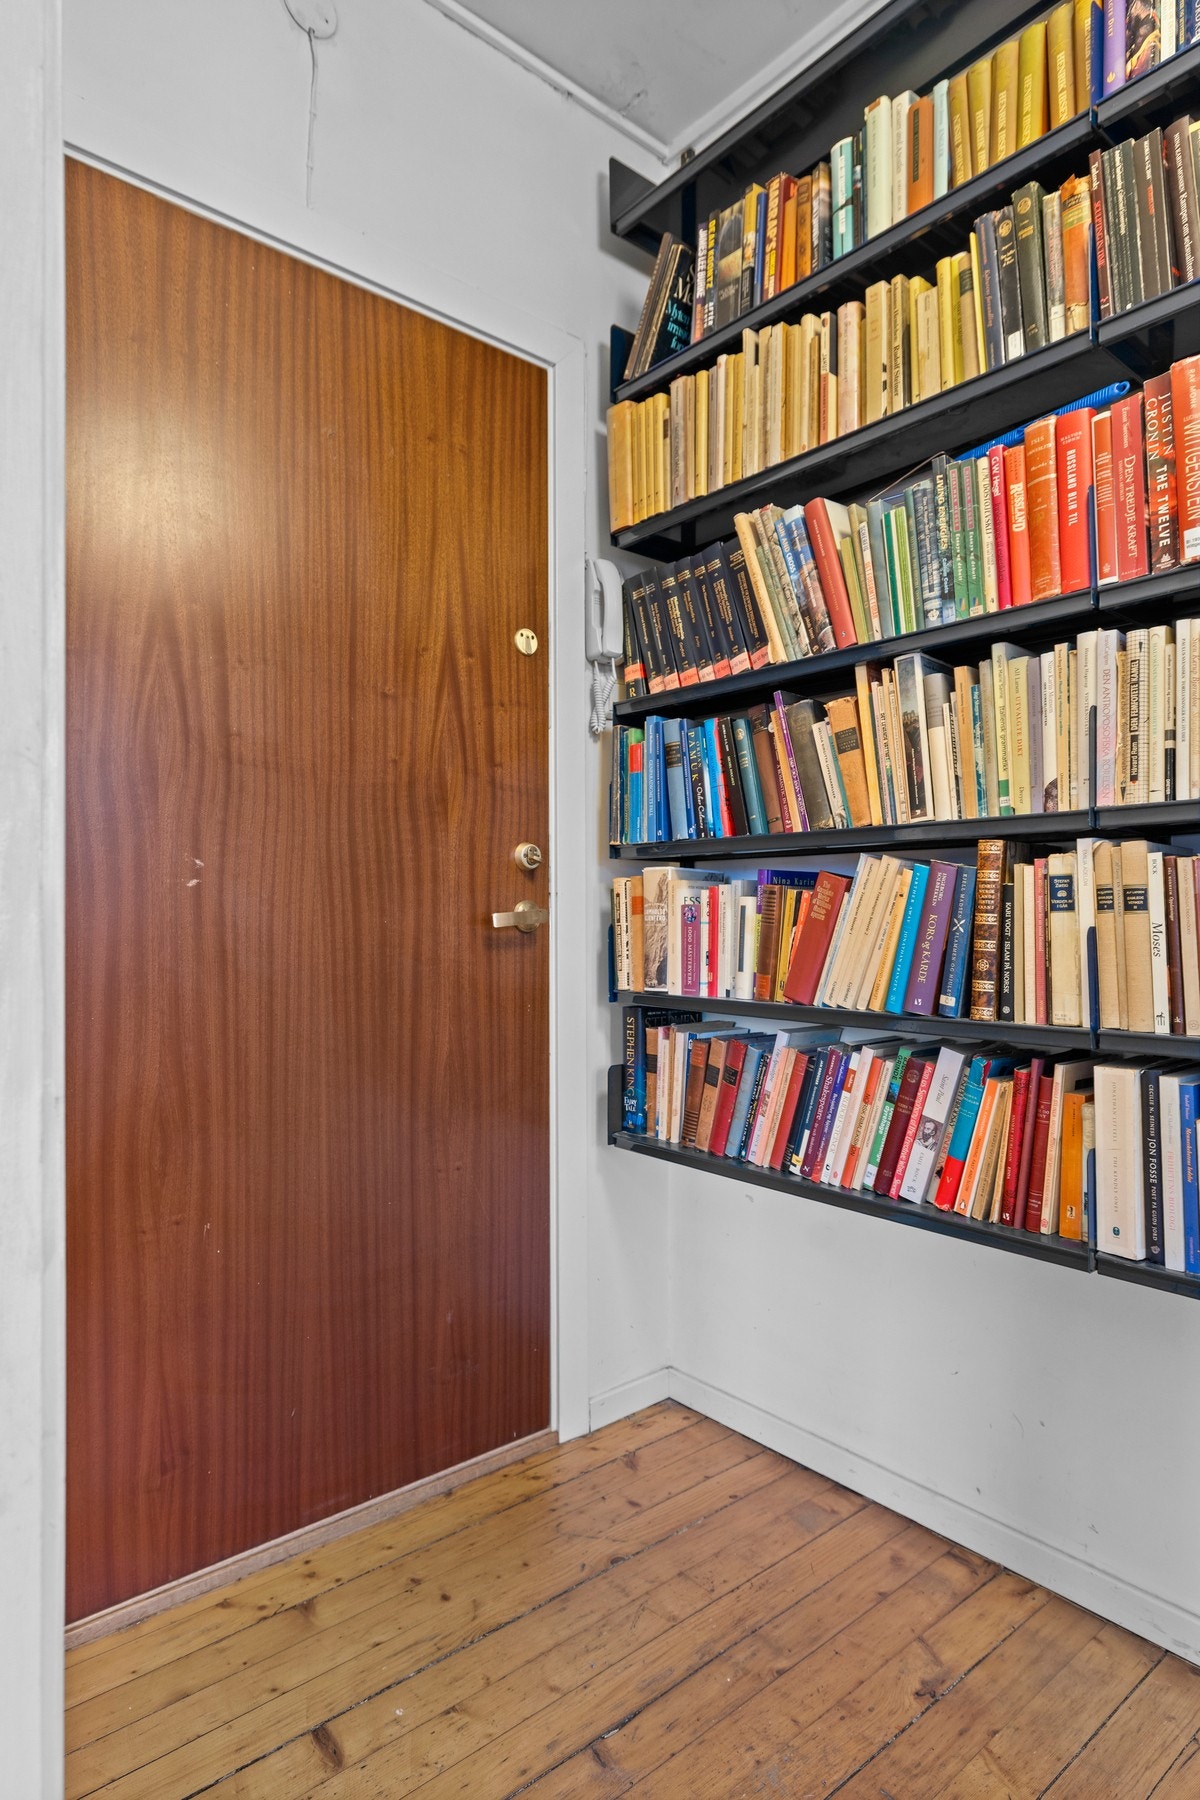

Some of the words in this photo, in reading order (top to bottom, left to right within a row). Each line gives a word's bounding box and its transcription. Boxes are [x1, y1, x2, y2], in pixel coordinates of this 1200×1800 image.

[1056, 51, 1066, 92] HENRIK
[1023, 73, 1032, 115] HENRIK
[1058, 90, 1068, 122] IBSEN
[998, 90, 1007, 131] HENRIK
[1180, 192, 1190, 225] Kampen
[698, 229, 708, 257] JAMES
[708, 218, 716, 248] DEAN
[706, 250, 715, 289] KOONTZ
[1183, 236, 1195, 284] seksualiteten
[696, 271, 706, 299] BURKE
[1188, 369, 1197, 384] RAY
[1189, 386, 1198, 409] MONK
[1146, 398, 1160, 461] CRONIN
[1158, 392, 1173, 456] JUSTIN
[1031, 436, 1045, 446] ISIS
[1066, 449, 1077, 490] RUSSLAND
[1124, 455, 1136, 482] DEN
[1156, 465, 1168, 491] THE
[1184, 424, 1200, 521] WITTGENSTEIN
[936, 474, 945, 505] LIVING
[992, 476, 1001, 497] Hegel
[1010, 482, 1026, 532] RUSSLAND
[1067, 492, 1078, 510] BLIR
[1124, 482, 1136, 522] TREDJE
[938, 506, 948, 550] ENERGIES
[1068, 512, 1078, 527] TIL
[1158, 494, 1171, 547] TWELVE
[1128, 524, 1138, 558] KRAFT
[782, 538, 790, 553] AND
[786, 552, 796, 574] CROSS
[1102, 669, 1110, 686] DEN
[1130, 660, 1139, 682] KAMEL
[630, 688, 637, 697] R
[1130, 684, 1139, 717] FEMFOTETE
[999, 706, 1007, 733] Italiensk
[1102, 687, 1111, 757] ANTROPOSOFISKA
[1130, 718, 1139, 731] DEN
[688, 732, 699, 781] PAMUK
[1000, 734, 1009, 772] grammatikk
[773, 876, 791, 885] Nina
[794, 877, 815, 886] Karin
[910, 873, 920, 903] FARTHER
[938, 873, 948, 901] INGEBORG
[926, 914, 938, 941] KORS
[1152, 922, 1163, 957] Moses
[898, 931, 909, 963] JONATHAN
[922, 942, 930, 950] og
[952, 932, 960, 961] FLAMMEN
[892, 964, 901, 992] FRANZEN
[918, 951, 931, 984] KARDE
[950, 963, 956, 972] OG
[1004, 962, 1012, 970] PÅ
[645, 1014, 700, 1028] STEPHEN
[626, 1017, 635, 1066] STEPHEN
[892, 1055, 903, 1081] GRINDE
[923, 1067, 933, 1080] Man
[938, 1074, 949, 1088] Saint
[626, 1068, 635, 1097] KING
[816, 1075, 833, 1121] Shakespeare
[860, 1094, 871, 1115] NORSK
[913, 1089, 928, 1117] Symphony
[936, 1090, 946, 1104] Paul
[879, 1106, 891, 1135] dyrehage
[908, 1126, 918, 1135] the
[850, 1116, 865, 1157] RIMLEKSIKON
[901, 1136, 913, 1160] Creative
[1146, 1138, 1157, 1156] JON
[898, 1160, 906, 1176] Word
[916, 1152, 924, 1167] EMIL
[1150, 1158, 1158, 1184] FOSSE
[912, 1168, 920, 1182] BOCK
